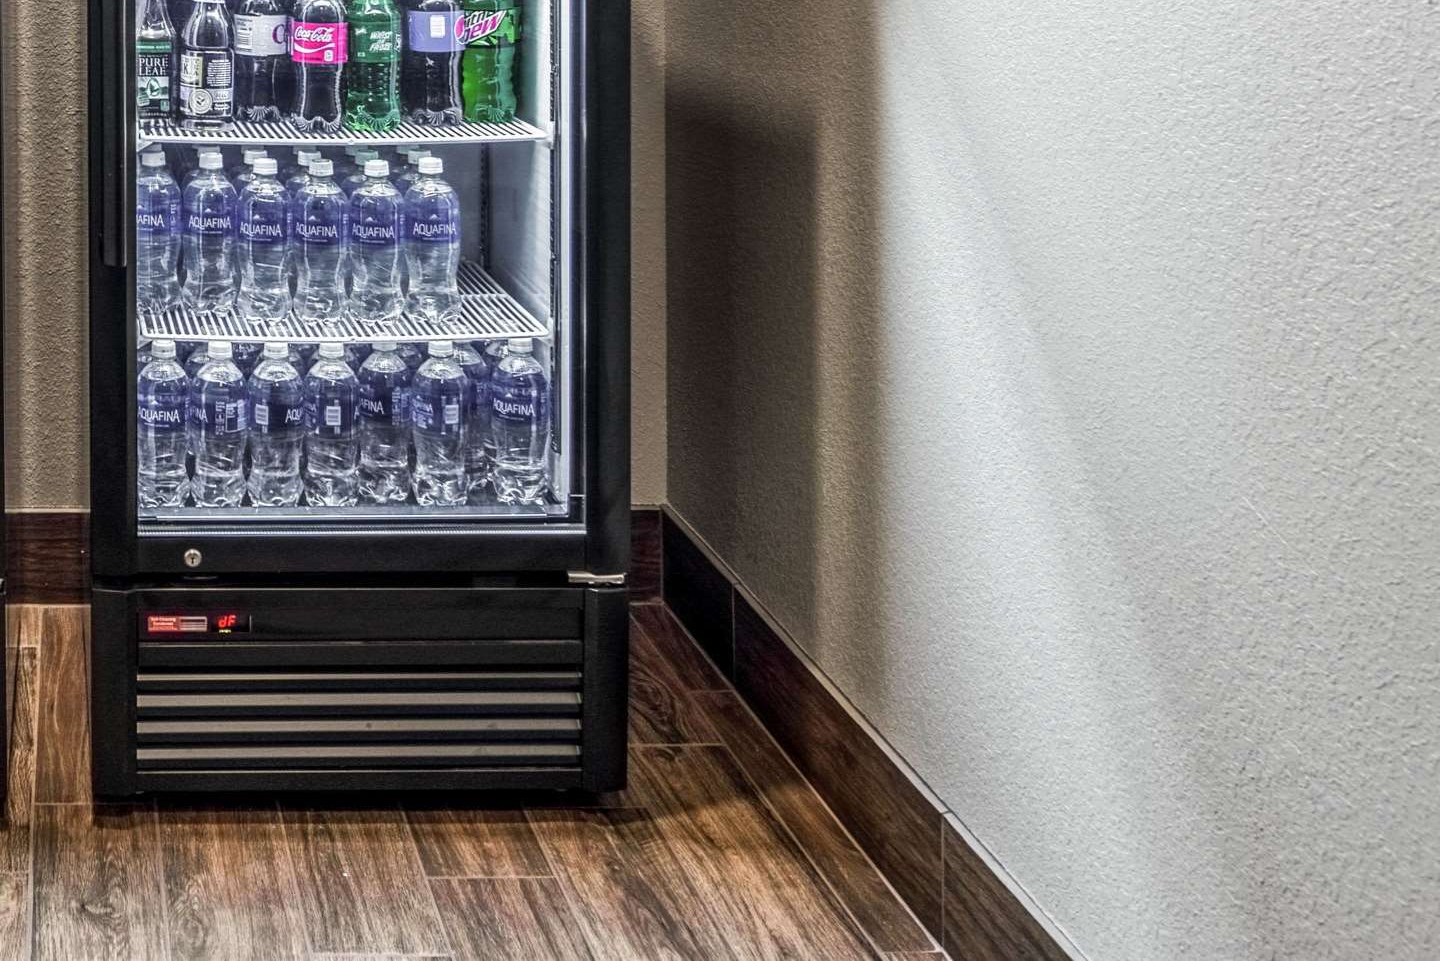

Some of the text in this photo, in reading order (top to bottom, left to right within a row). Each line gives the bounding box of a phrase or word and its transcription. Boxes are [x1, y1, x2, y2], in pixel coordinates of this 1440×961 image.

[294, 26, 336, 43] Coca-Cola
[138, 57, 169, 67] PURE
[138, 67, 167, 76] LEAF
[189, 214, 232, 230] AQUAFINA
[240, 221, 283, 237] AQUAFINA
[295, 221, 339, 238] AQUAFINA
[413, 221, 458, 237] AQUAFINA
[352, 222, 396, 239] AQUAFINA
[493, 398, 536, 417] AQUAFINA
